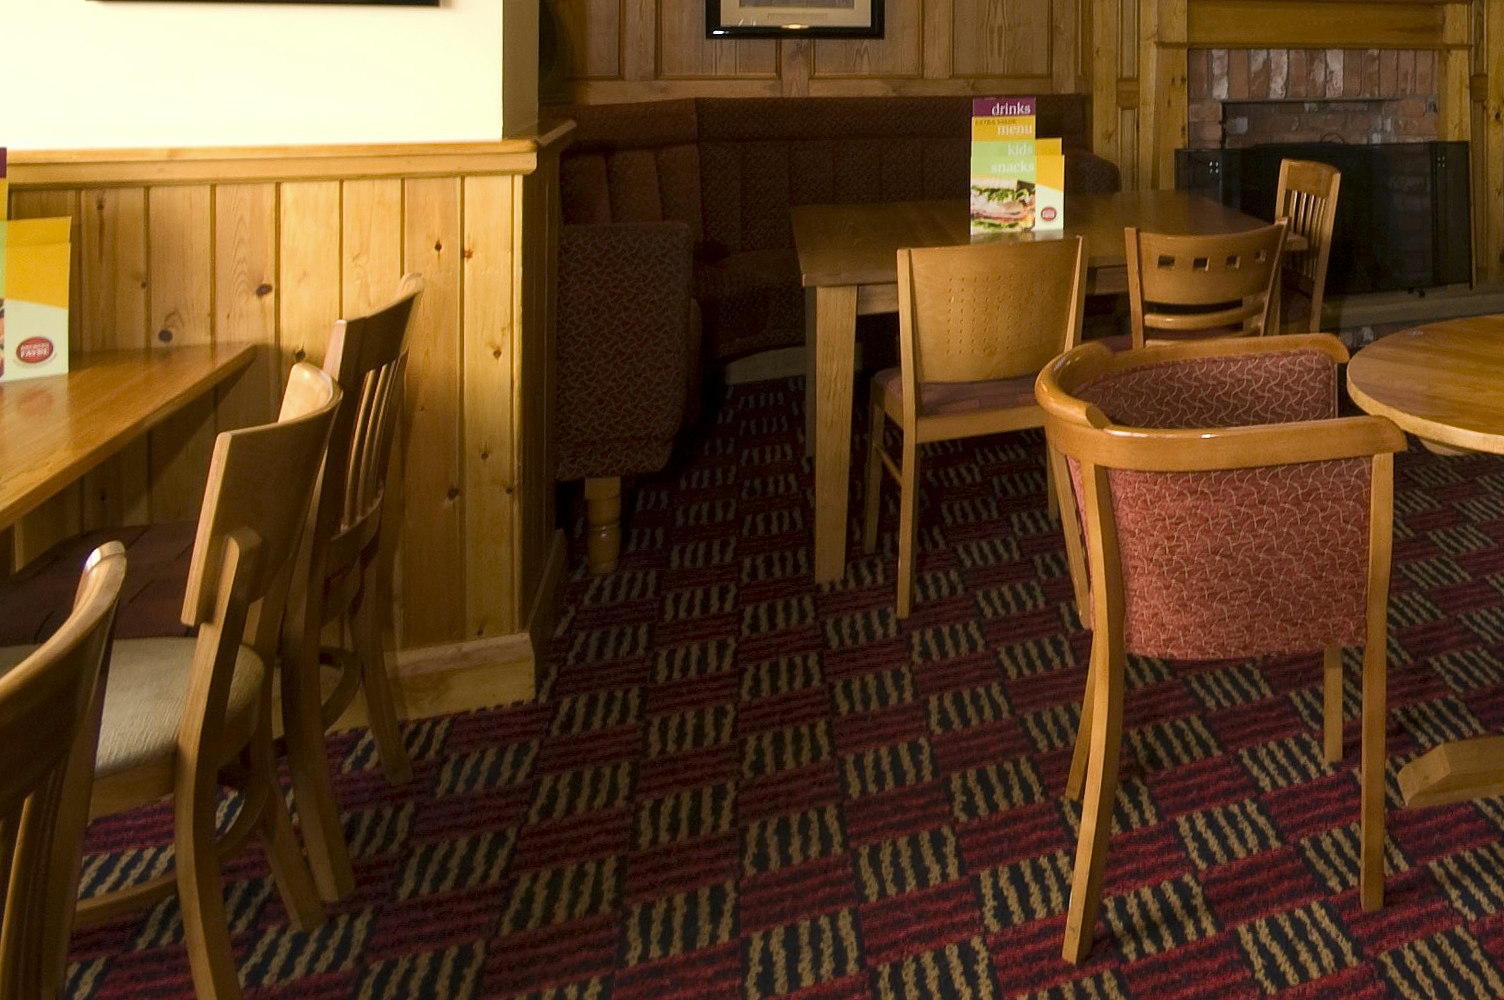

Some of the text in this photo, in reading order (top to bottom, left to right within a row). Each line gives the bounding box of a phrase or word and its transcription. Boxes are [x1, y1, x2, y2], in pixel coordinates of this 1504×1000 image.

[991, 102, 1032, 116] drinks
[997, 124, 1033, 136] menu
[1007, 143, 1034, 156] kids
[991, 161, 1035, 174] snacks
